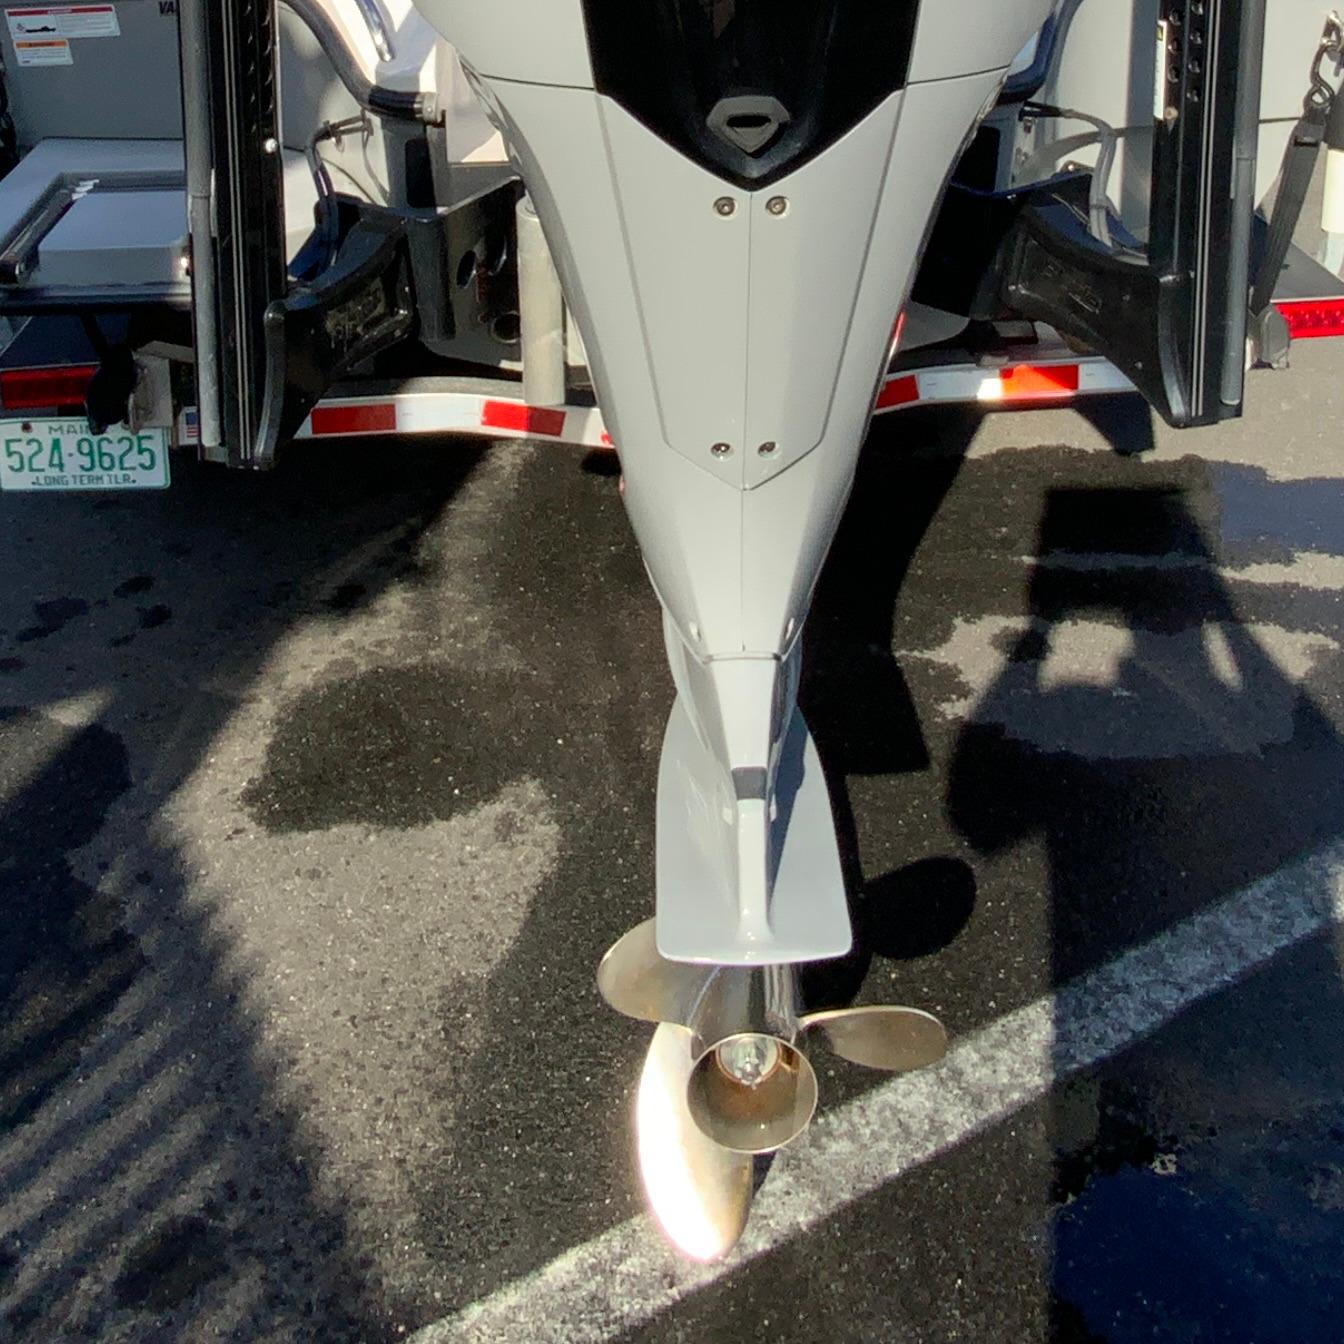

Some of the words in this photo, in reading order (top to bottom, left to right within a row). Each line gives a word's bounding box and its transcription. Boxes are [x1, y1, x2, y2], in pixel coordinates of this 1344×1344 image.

[4, 435, 157, 473] 524-9625
[36, 474, 69, 487] LONG
[71, 474, 104, 486] TERM
